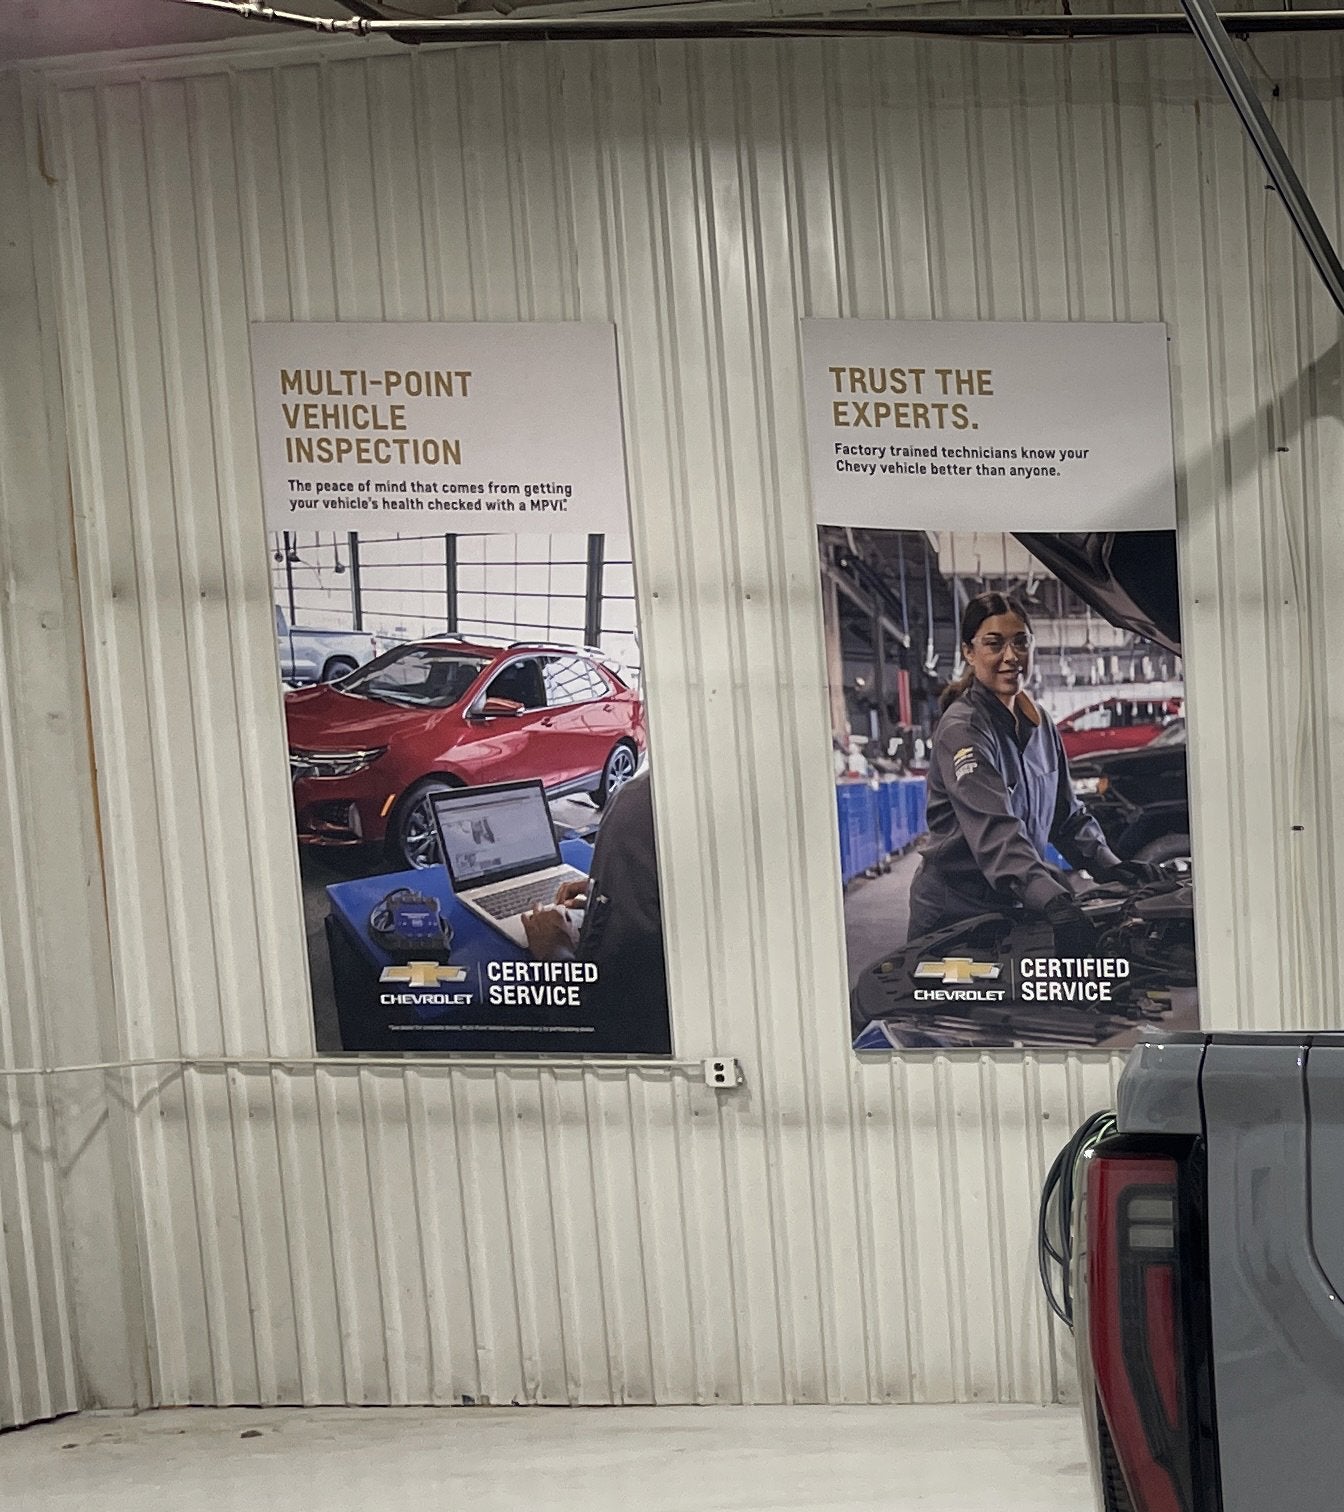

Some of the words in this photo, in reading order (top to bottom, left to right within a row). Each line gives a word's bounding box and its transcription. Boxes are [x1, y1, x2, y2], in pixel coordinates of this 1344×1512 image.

[280, 370, 471, 397] MULTI-POINT
[829, 367, 926, 394] TRUST
[935, 369, 994, 396] THE
[282, 404, 406, 430] VEHICLE
[833, 401, 978, 430] EXPERTS.
[285, 437, 461, 464] INSPECTION
[835, 443, 886, 458] Factory
[890, 444, 937, 458] trained
[941, 446, 1017, 460] technicians
[1021, 446, 1056, 459] know
[1059, 448, 1089, 462] your
[836, 460, 876, 475] Chevy
[880, 461, 927, 475] vehicle
[931, 462, 971, 475] better
[976, 463, 1006, 476] than
[1010, 464, 1061, 479] anyone.
[288, 479, 311, 492] The
[316, 480, 353, 494] peace
[358, 480, 371, 492] of
[375, 480, 406, 493] mind
[411, 480, 438, 494] that
[442, 483, 484, 494] comes
[488, 481, 520, 495] from
[524, 481, 572, 497] getting
[290, 498, 318, 511] your
[323, 496, 378, 510] vehicle's
[382, 497, 423, 510] health
[428, 498, 482, 511] checked
[486, 498, 514, 511] with
[519, 500, 526, 511] a
[488, 961, 598, 982] CERTIFIED
[1021, 958, 1129, 978] CERTIFIED
[379, 993, 473, 1005] CHEVROLET
[489, 985, 580, 1006] SERVICE
[914, 990, 1005, 1001] CHEVROLET
[1021, 982, 1112, 1001] SERVICE
